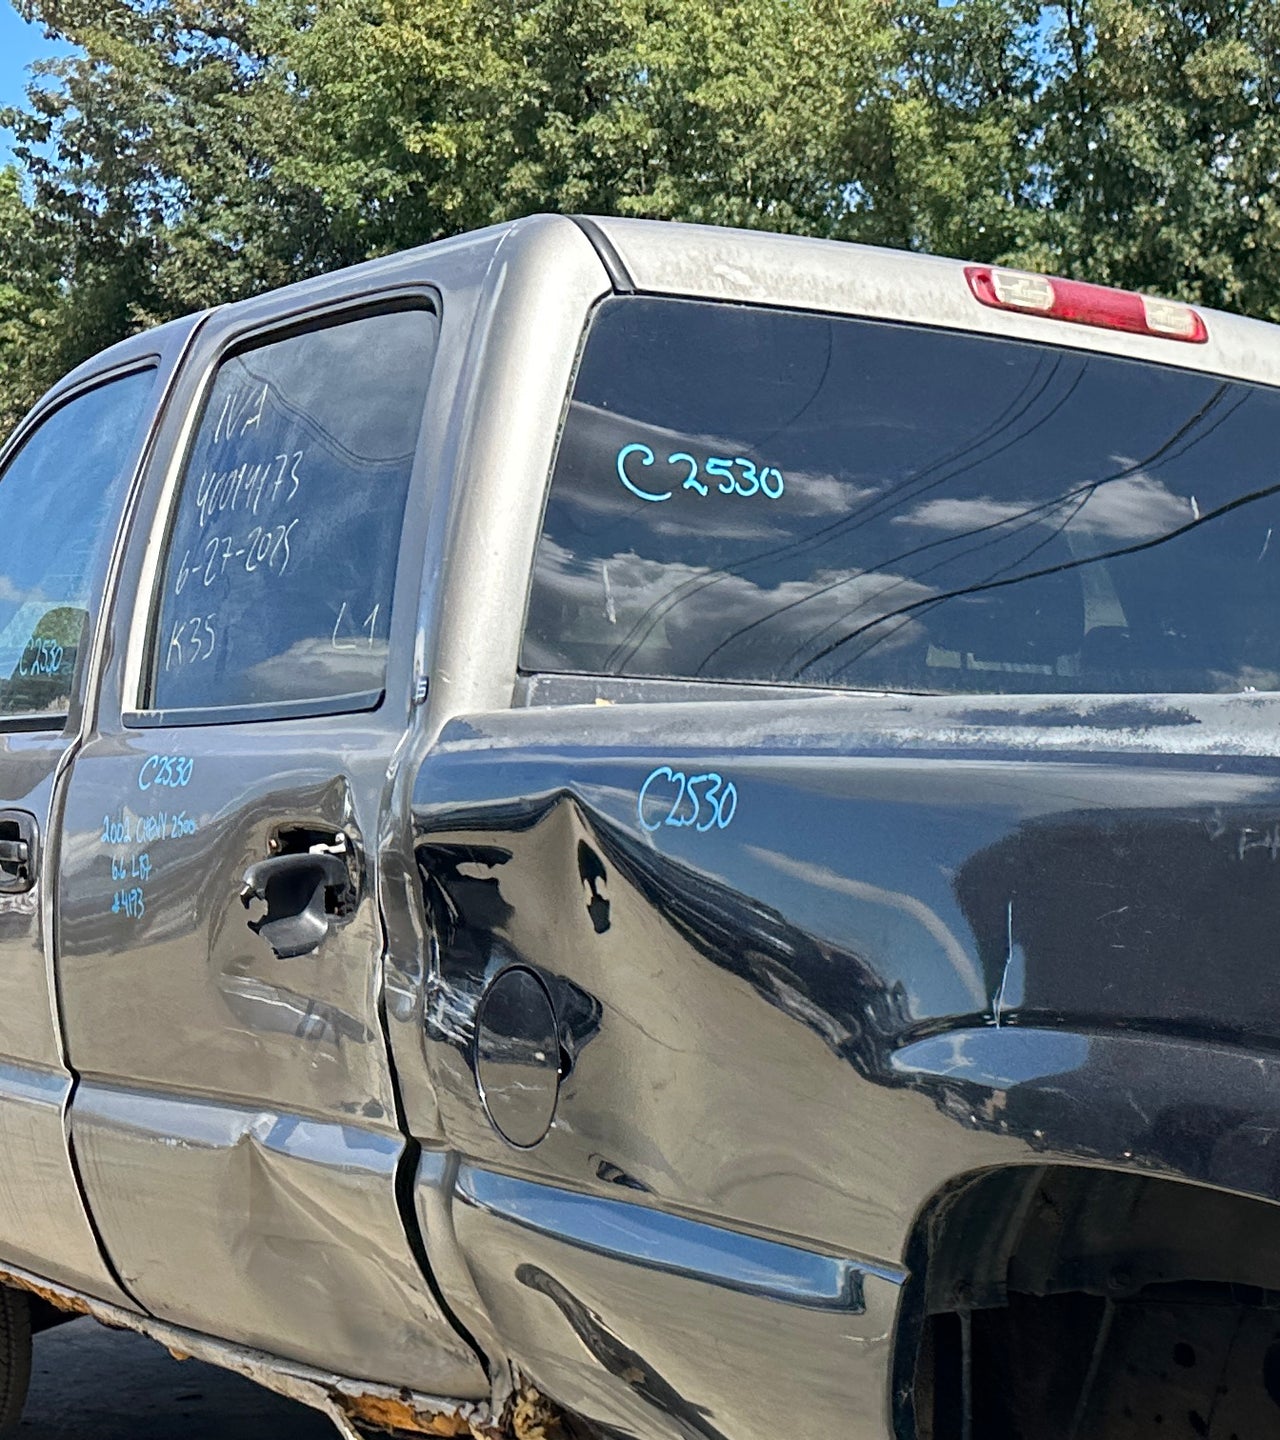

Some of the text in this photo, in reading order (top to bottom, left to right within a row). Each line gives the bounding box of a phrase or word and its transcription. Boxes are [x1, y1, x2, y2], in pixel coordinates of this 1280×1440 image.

[617, 443, 784, 501] C2530
[19, 637, 63, 676] C2530
[138, 754, 193, 791] C2530
[638, 766, 738, 832] C2530
[101, 815, 131, 843] 2002
[171, 810, 196, 838] 2500
